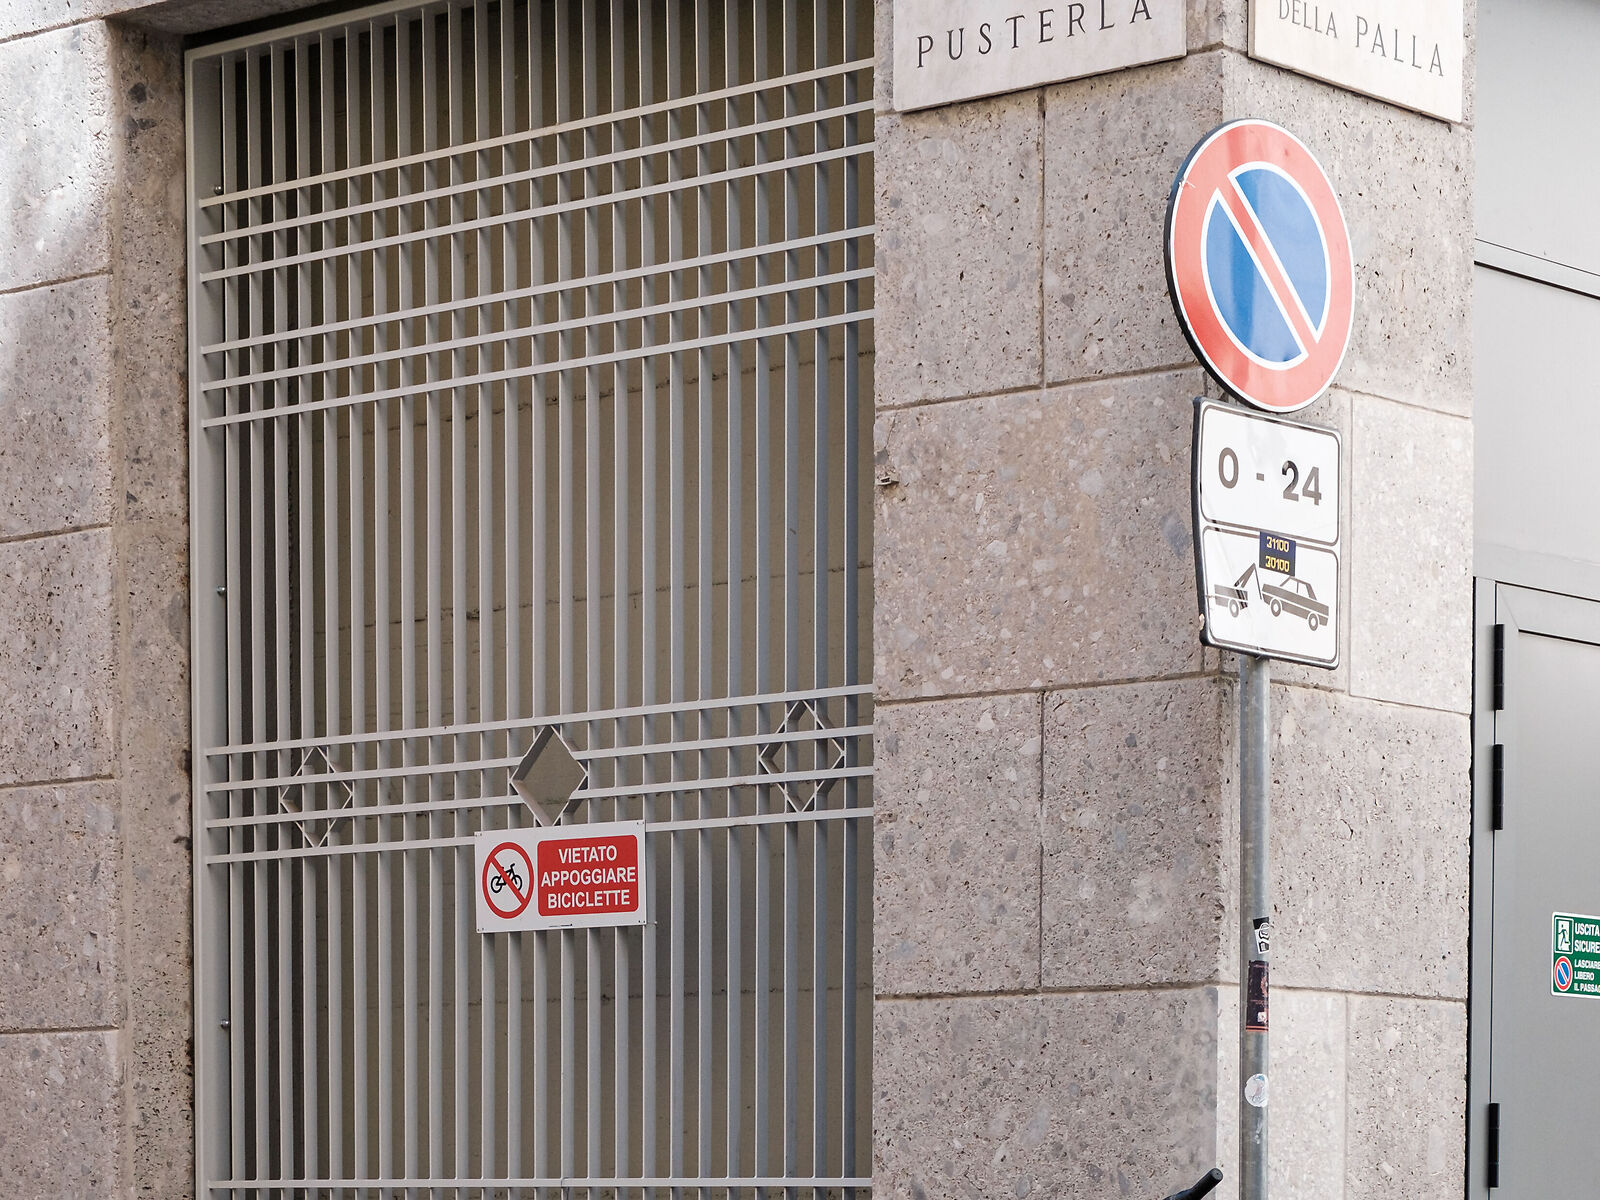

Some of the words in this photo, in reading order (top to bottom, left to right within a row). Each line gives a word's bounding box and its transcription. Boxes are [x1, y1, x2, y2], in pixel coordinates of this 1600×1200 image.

[916, 0, 1152, 69] PUSTERLA
[1279, 0, 1338, 39] DELLA
[1355, 15, 1444, 77] PALLA
[1281, 460, 1322, 506] 24
[1265, 555, 1289, 572] 30100
[558, 845, 618, 864] VIETATO
[541, 866, 637, 888] APPOGGIARE
[547, 889, 631, 909] BICICLETTE
[1575, 922, 1600, 936] USCITA
[1574, 971, 1594, 980] LIBERO
[1574, 983, 1579, 991] IL
